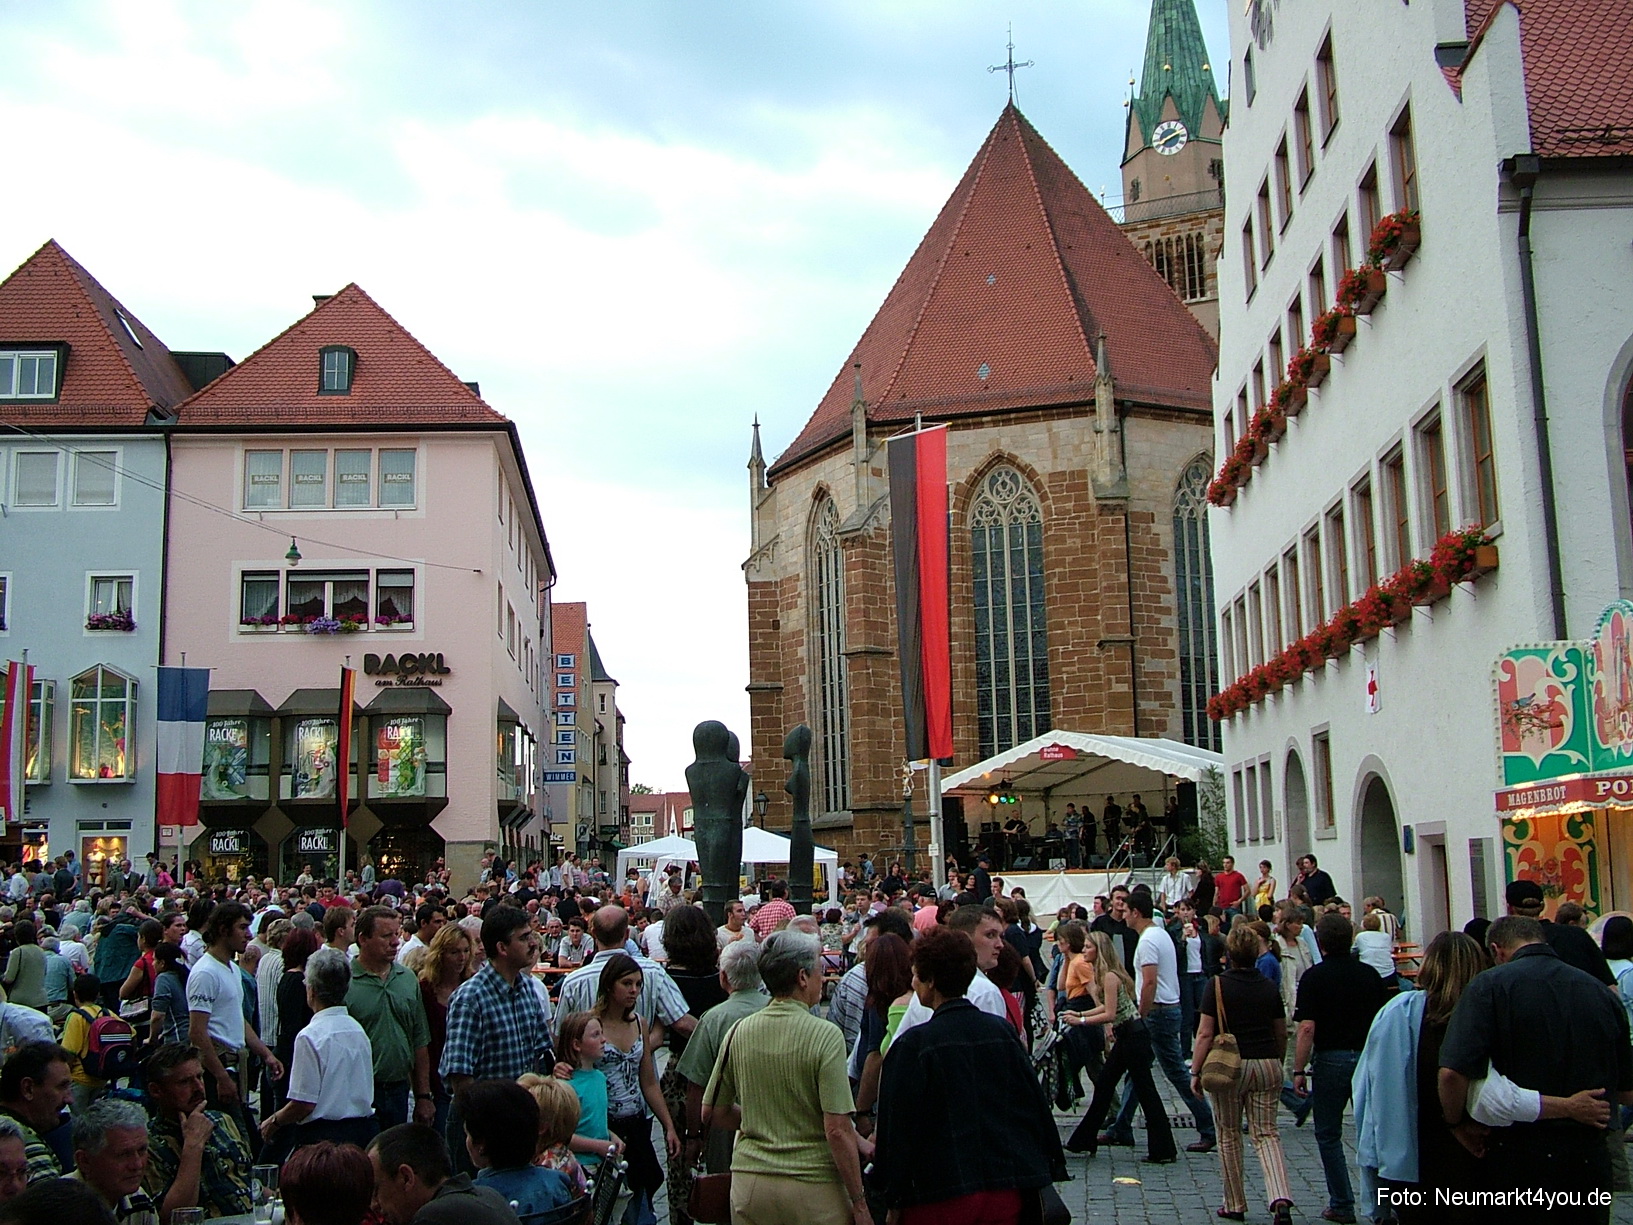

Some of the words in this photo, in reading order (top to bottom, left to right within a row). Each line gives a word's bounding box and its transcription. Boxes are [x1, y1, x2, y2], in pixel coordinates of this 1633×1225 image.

[363, 652, 451, 675] RACKL
[374, 679, 393, 687] am
[394, 674, 443, 687] Rathaus
[559, 656, 572, 761] BETTEN
[545, 773, 575, 781] WIMMER
[1507, 785, 1566, 806] MAGENBROT
[212, 838, 240, 851] RACKL
[301, 836, 328, 850] RACKL
